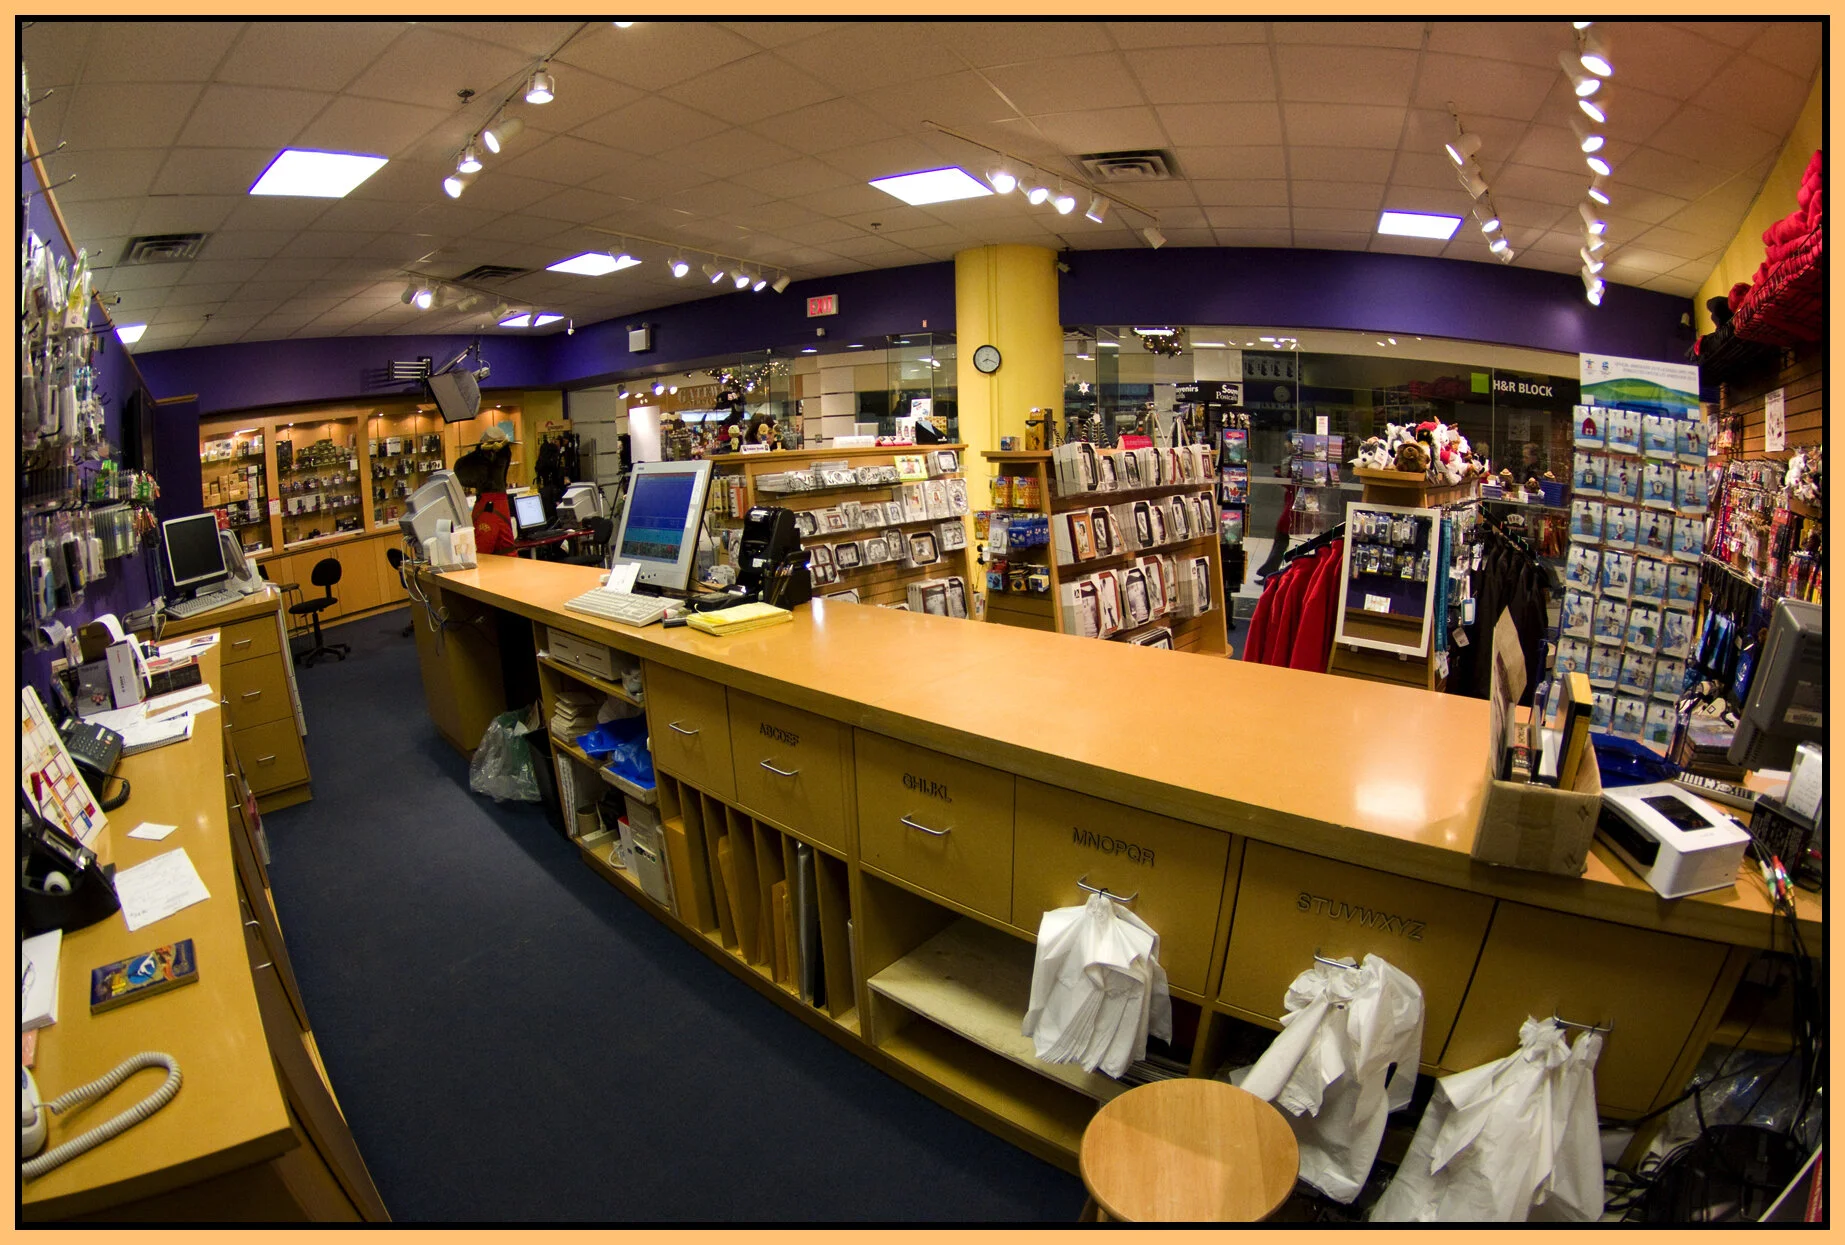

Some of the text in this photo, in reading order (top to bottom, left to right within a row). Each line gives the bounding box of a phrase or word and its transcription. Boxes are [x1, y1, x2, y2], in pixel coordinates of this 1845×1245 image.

[810, 296, 832, 315] EXIT
[1493, 380, 1553, 397] H&R BLOCK
[760, 722, 799, 746] ABCDEF
[902, 773, 952, 803] GHIJKL
[1072, 827, 1155, 867] MNOPQR
[1297, 892, 1427, 941] STUVWXYZ
